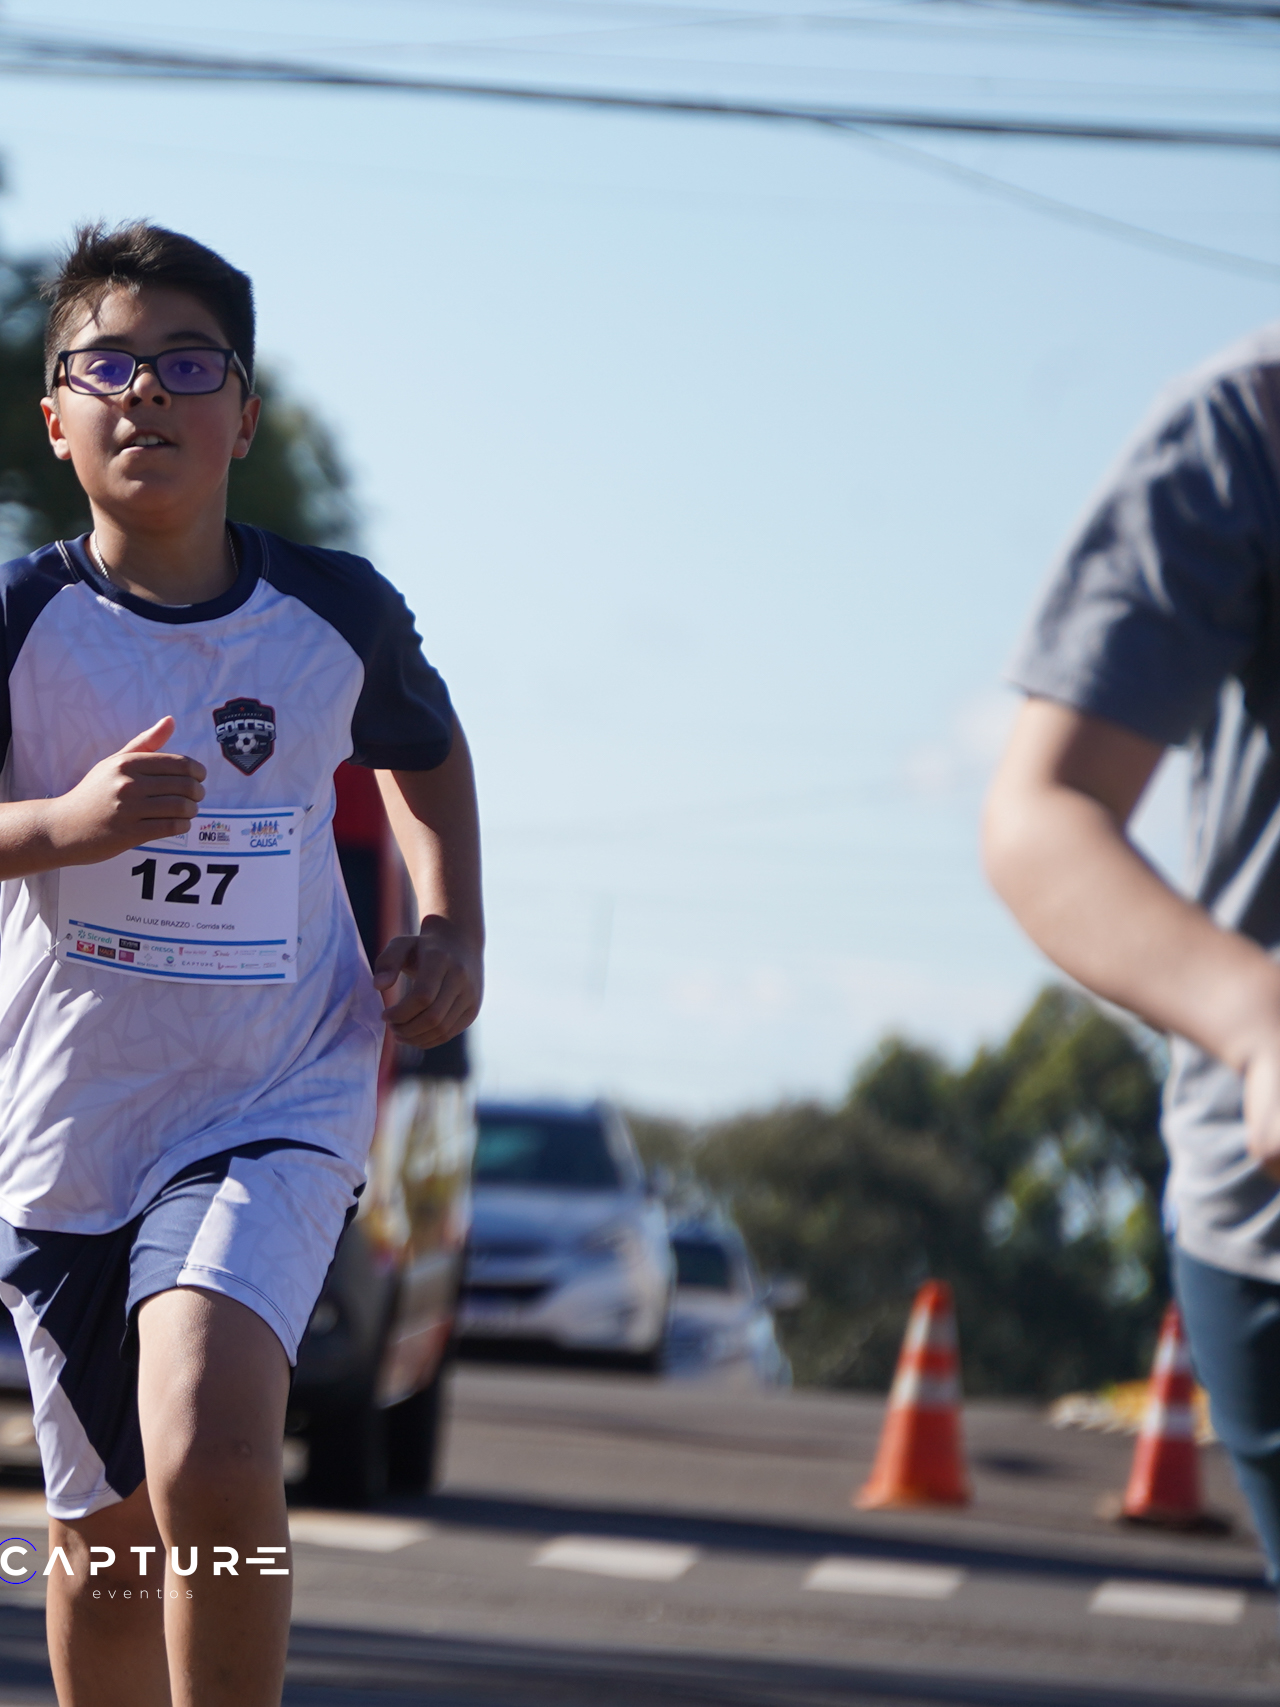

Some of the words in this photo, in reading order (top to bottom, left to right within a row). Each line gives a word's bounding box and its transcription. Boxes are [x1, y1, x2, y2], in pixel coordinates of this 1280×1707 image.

[216, 718, 276, 741] SOCCER
[199, 831, 216, 842] ONG
[250, 838, 278, 848] CAUSA
[131, 858, 240, 906] 127
[126, 914, 142, 924] DAVI
[143, 918, 159, 926] LUIZ
[160, 919, 190, 929] BRAZZO
[196, 922, 220, 930] Corrida
[87, 932, 113, 944] Sicredi
